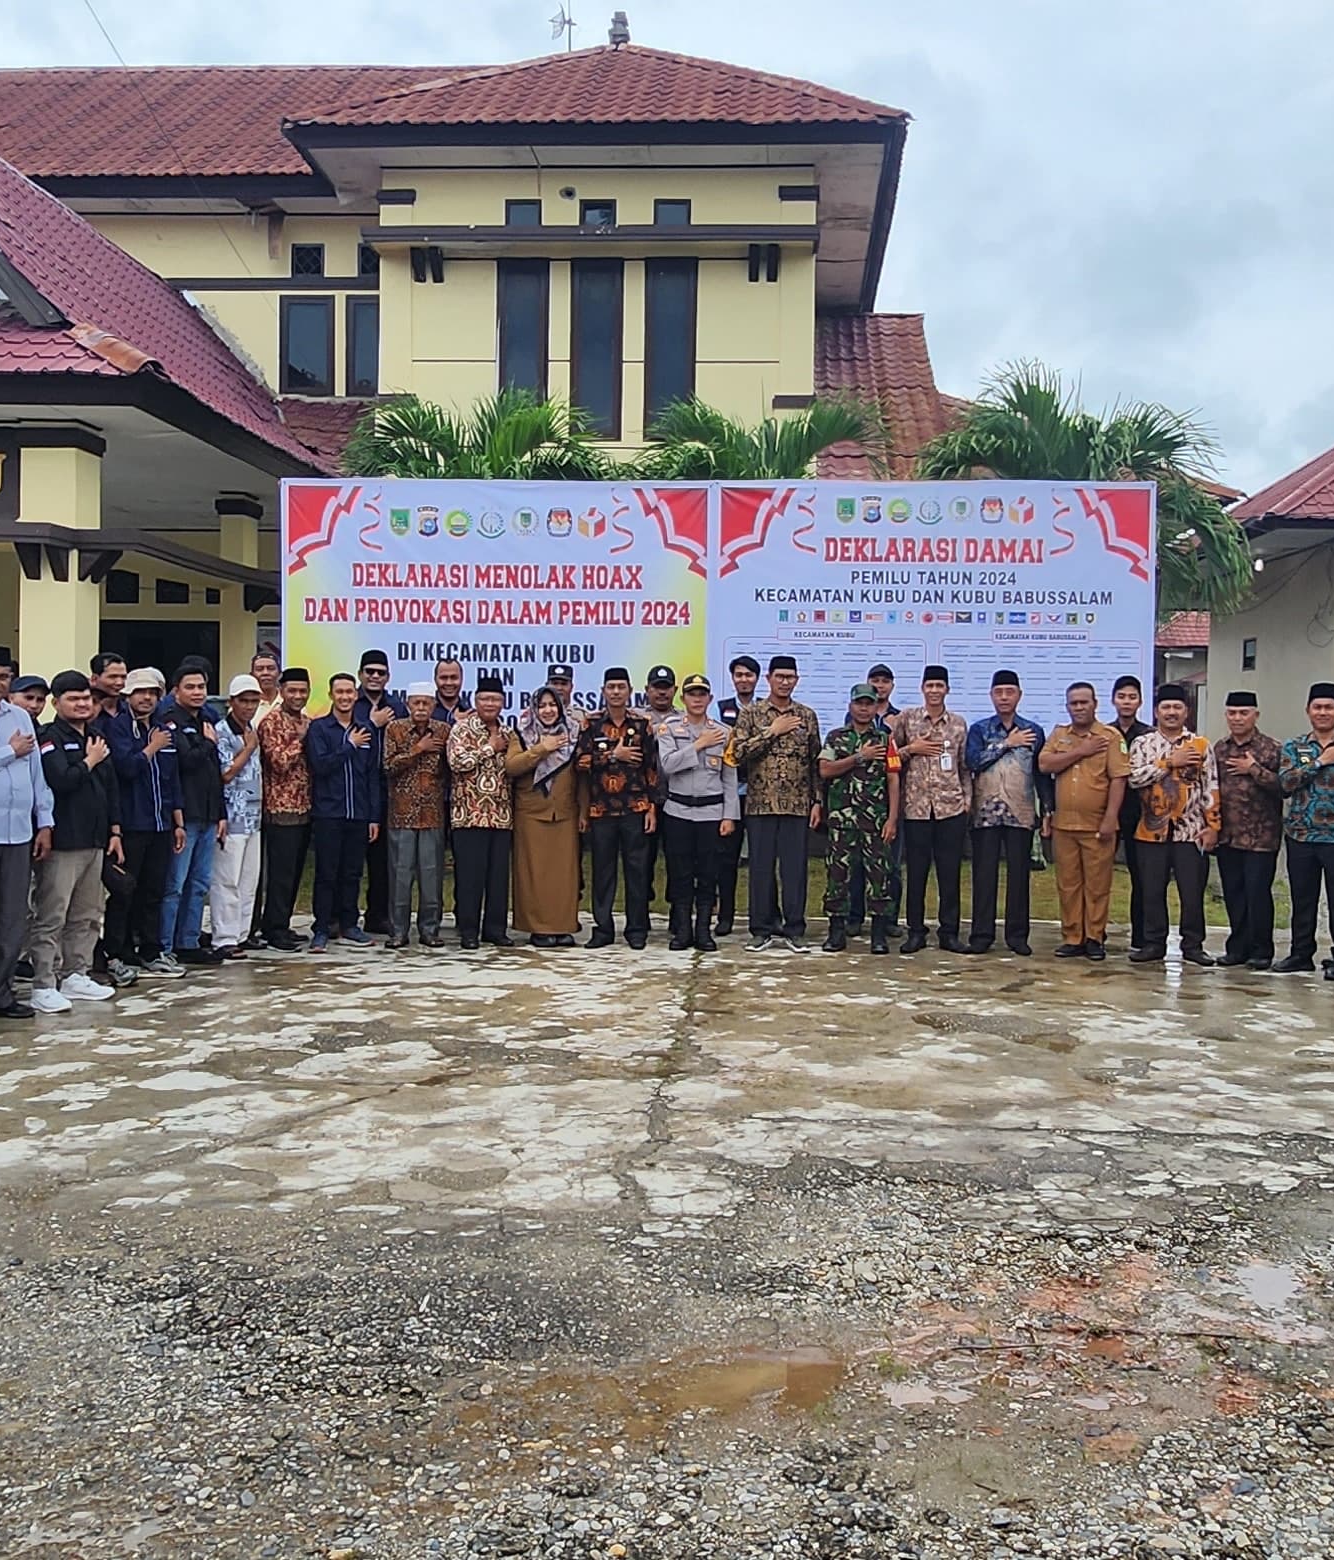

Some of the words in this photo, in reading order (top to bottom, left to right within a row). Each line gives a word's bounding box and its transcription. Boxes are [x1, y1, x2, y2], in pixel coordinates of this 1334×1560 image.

[824, 537, 957, 563] DEKLARASI
[964, 538, 1044, 563] DAMAI
[352, 562, 468, 588] DEKLARASI
[474, 563, 576, 590] MENOLAK
[582, 565, 643, 591] HOAX
[851, 570, 910, 585] PEMILU
[917, 571, 973, 586] TAHUN
[978, 572, 1017, 586] 2024
[754, 588, 854, 604] KECAMATAN
[860, 590, 905, 604] KUBU
[912, 590, 945, 604] DAN
[951, 591, 995, 605] KUBU
[1003, 592, 1113, 606] BABUSSALAM
[304, 598, 349, 623] DAN
[354, 598, 471, 625] PROVOKASI
[477, 600, 552, 626] DALAM
[558, 601, 636, 626] PEMILU
[641, 602, 691, 627] 2024
[397, 642, 416, 661] DI
[423, 643, 536, 663] KECAMATAN
[543, 645, 595, 664] KUBU
